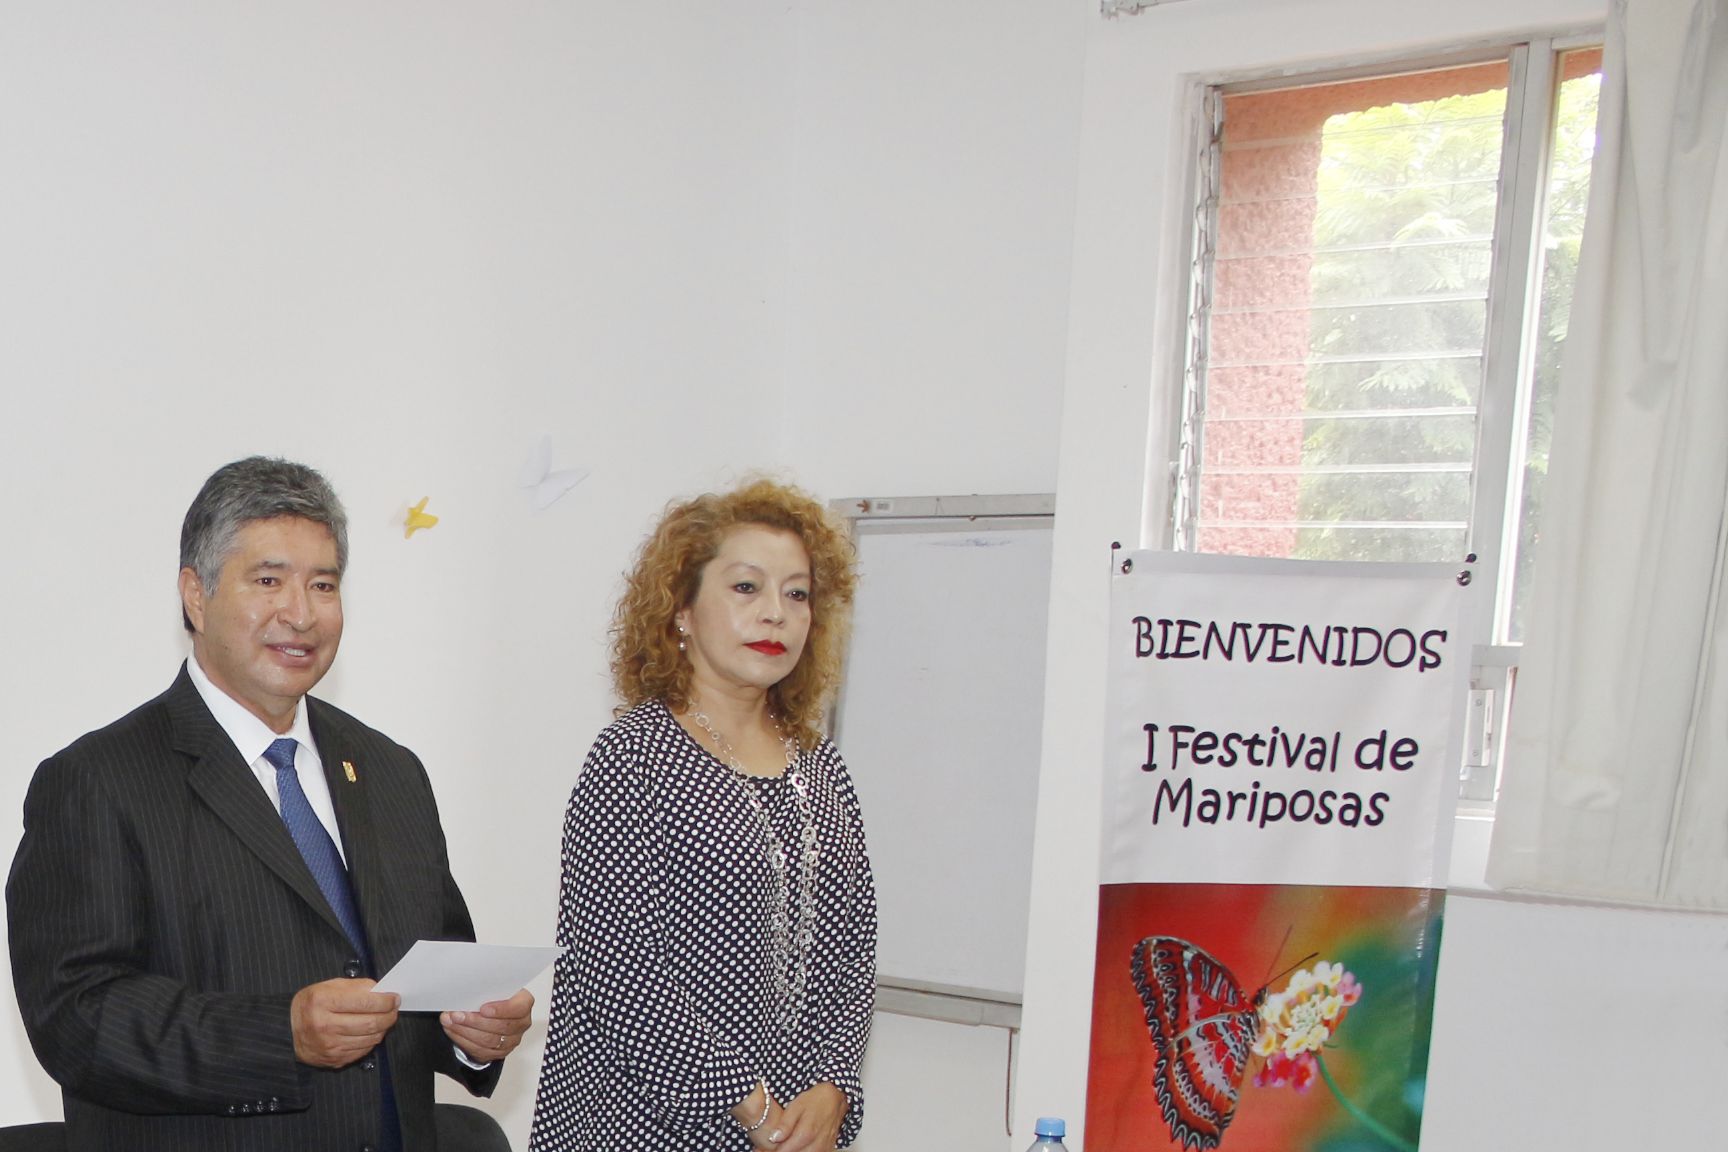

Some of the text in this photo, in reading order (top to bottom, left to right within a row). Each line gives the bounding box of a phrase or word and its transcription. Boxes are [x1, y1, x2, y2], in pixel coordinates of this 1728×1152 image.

[1132, 616, 1447, 672] BIENVENIDOS
[1141, 723, 1419, 773] I Festival de
[1152, 777, 1390, 829] Mariposas
